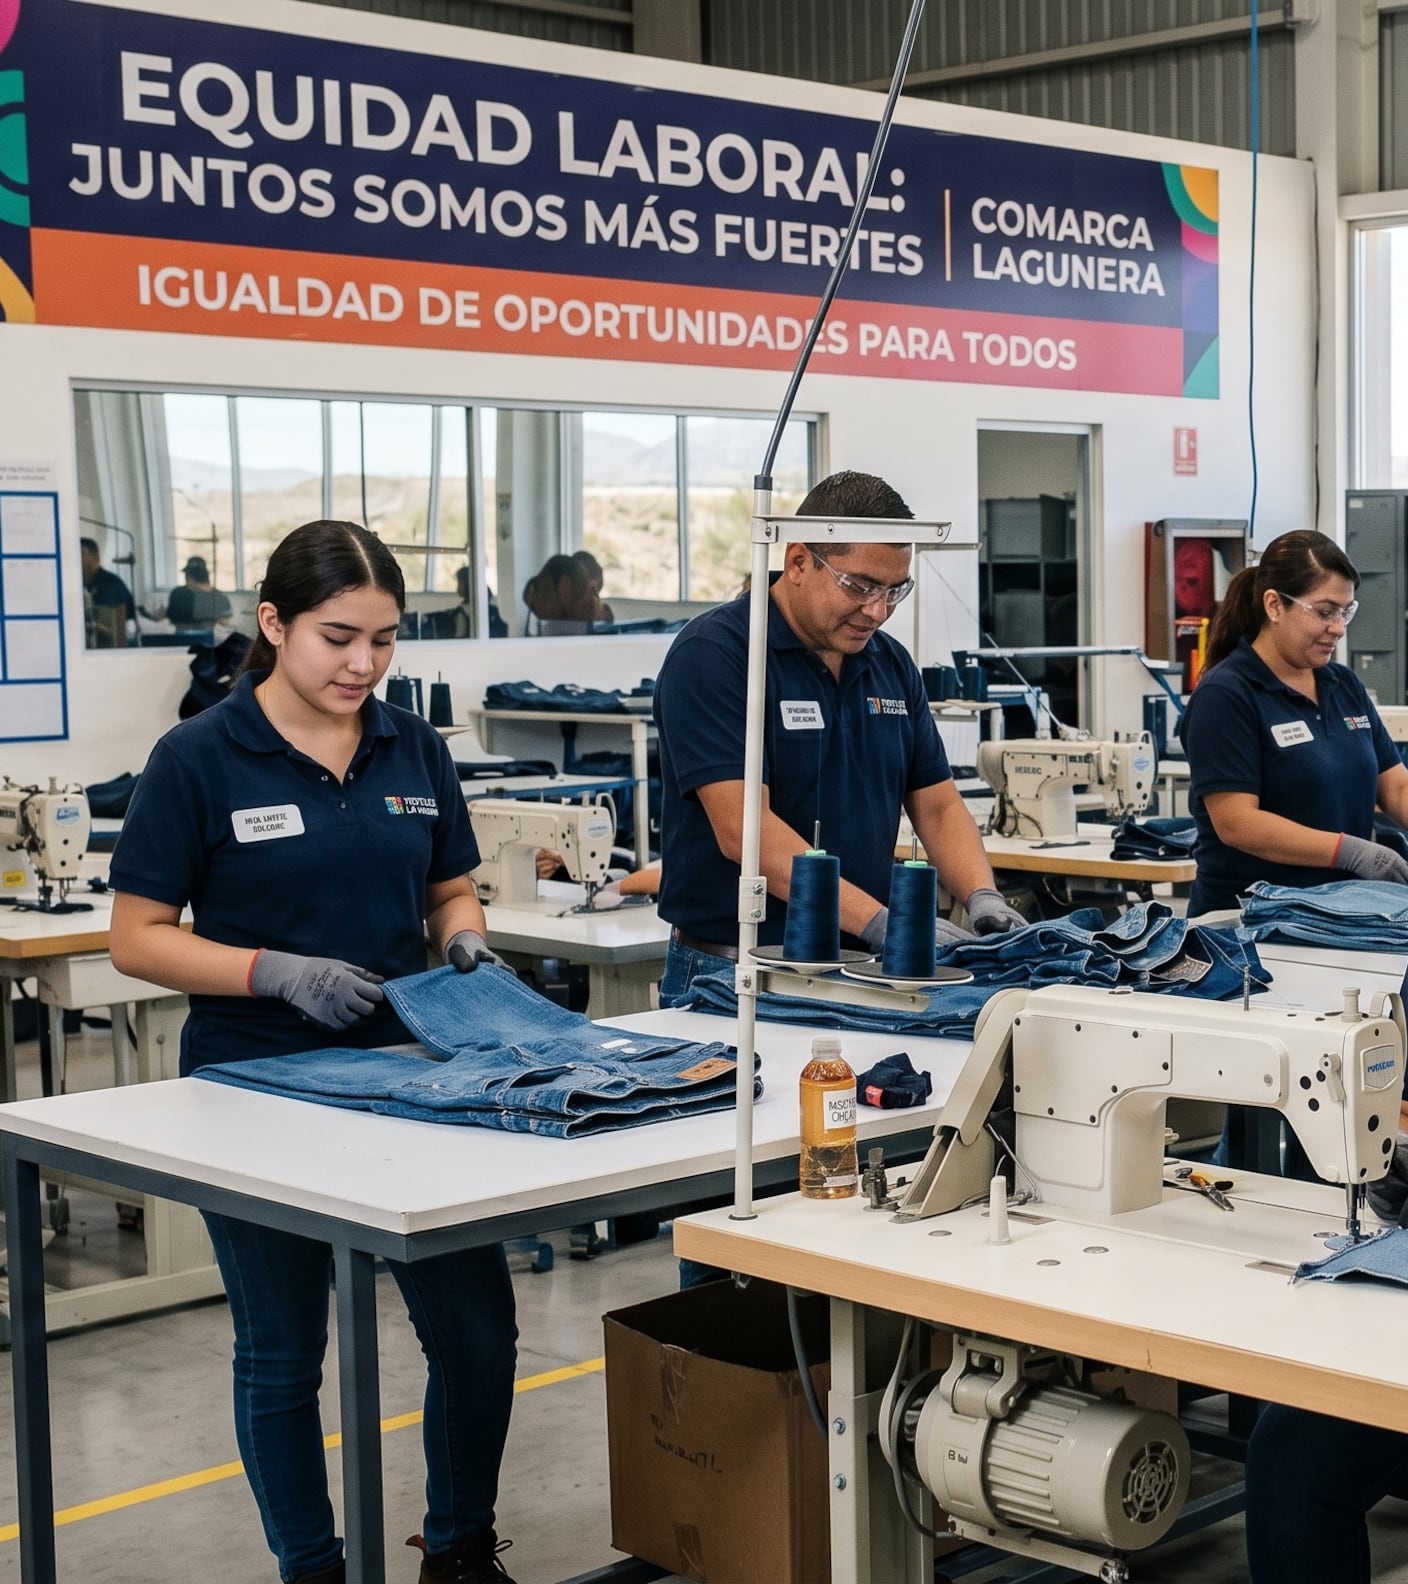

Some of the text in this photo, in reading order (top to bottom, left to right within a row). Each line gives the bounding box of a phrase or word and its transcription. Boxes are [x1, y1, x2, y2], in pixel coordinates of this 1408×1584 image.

[121, 51, 906, 214] EQUIDAD LABORAL:
[69, 142, 924, 277] JUNTOS SOMOS MÁS FUERTES
[971, 197, 1155, 253] COMARCA
[137, 265, 1078, 373] IGUALDAD DE OPORTUNIDADES PARA TODOS
[973, 242, 1166, 298] LAGUNERA
